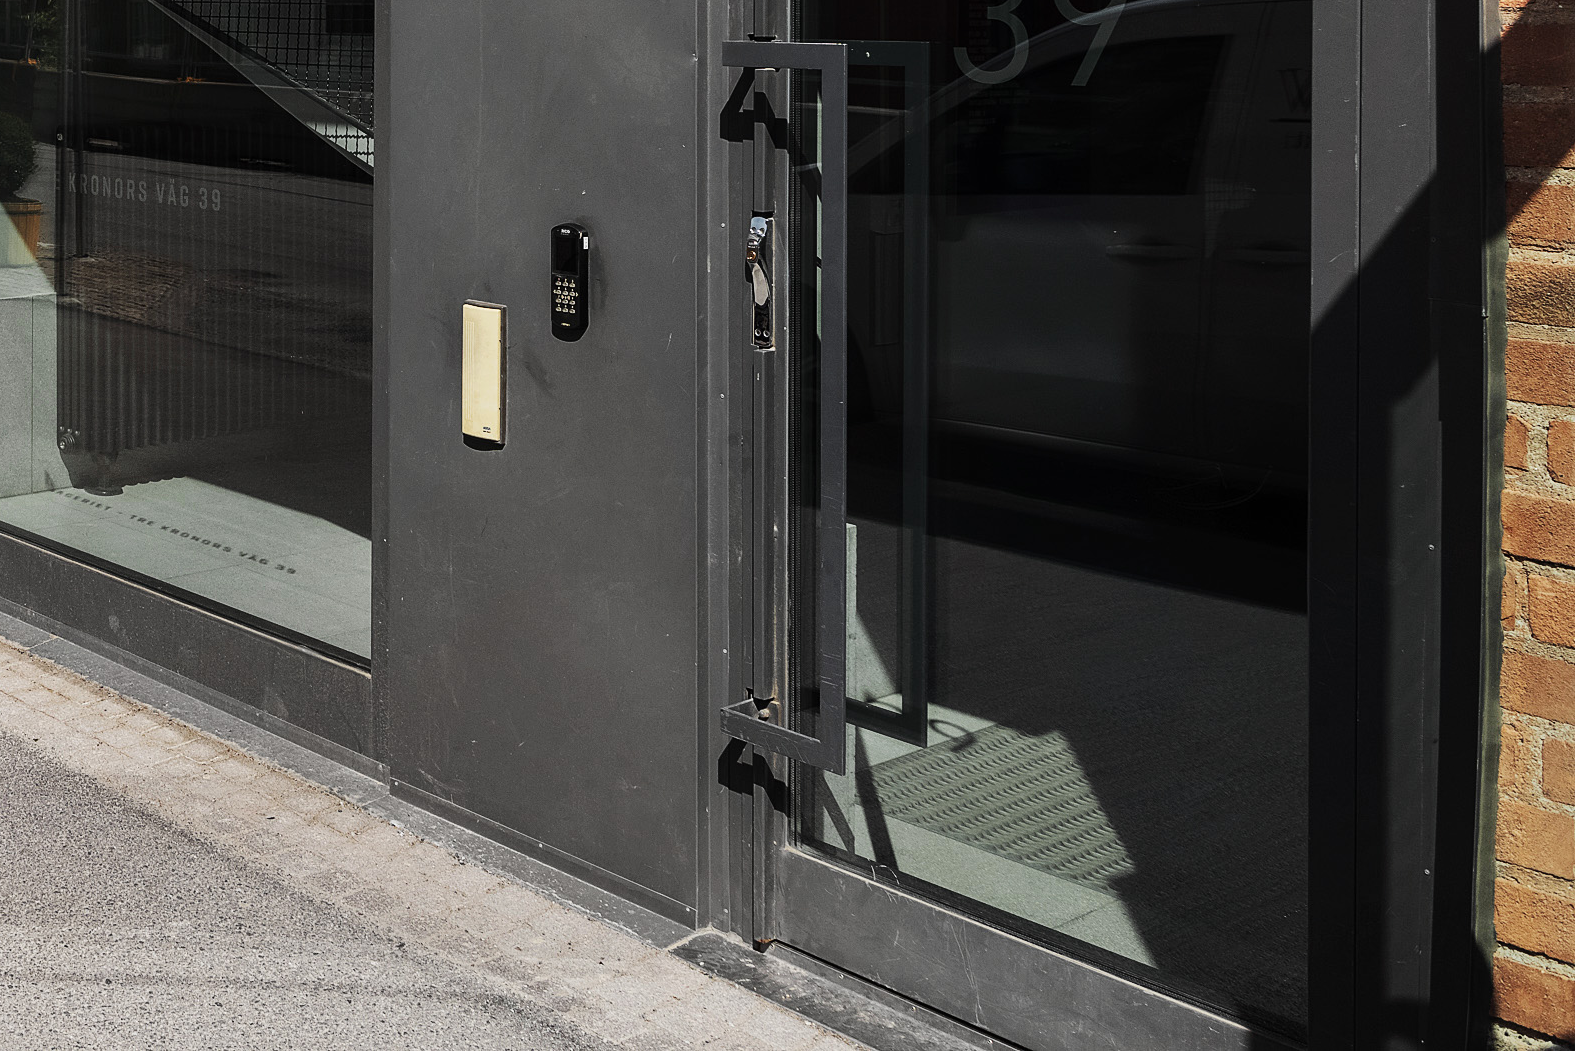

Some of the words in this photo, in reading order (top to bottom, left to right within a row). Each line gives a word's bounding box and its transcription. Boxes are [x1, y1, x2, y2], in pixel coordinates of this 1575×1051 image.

[68, 172, 147, 202] KRONORS
[156, 178, 189, 208] VÄG
[199, 188, 221, 211] 39
